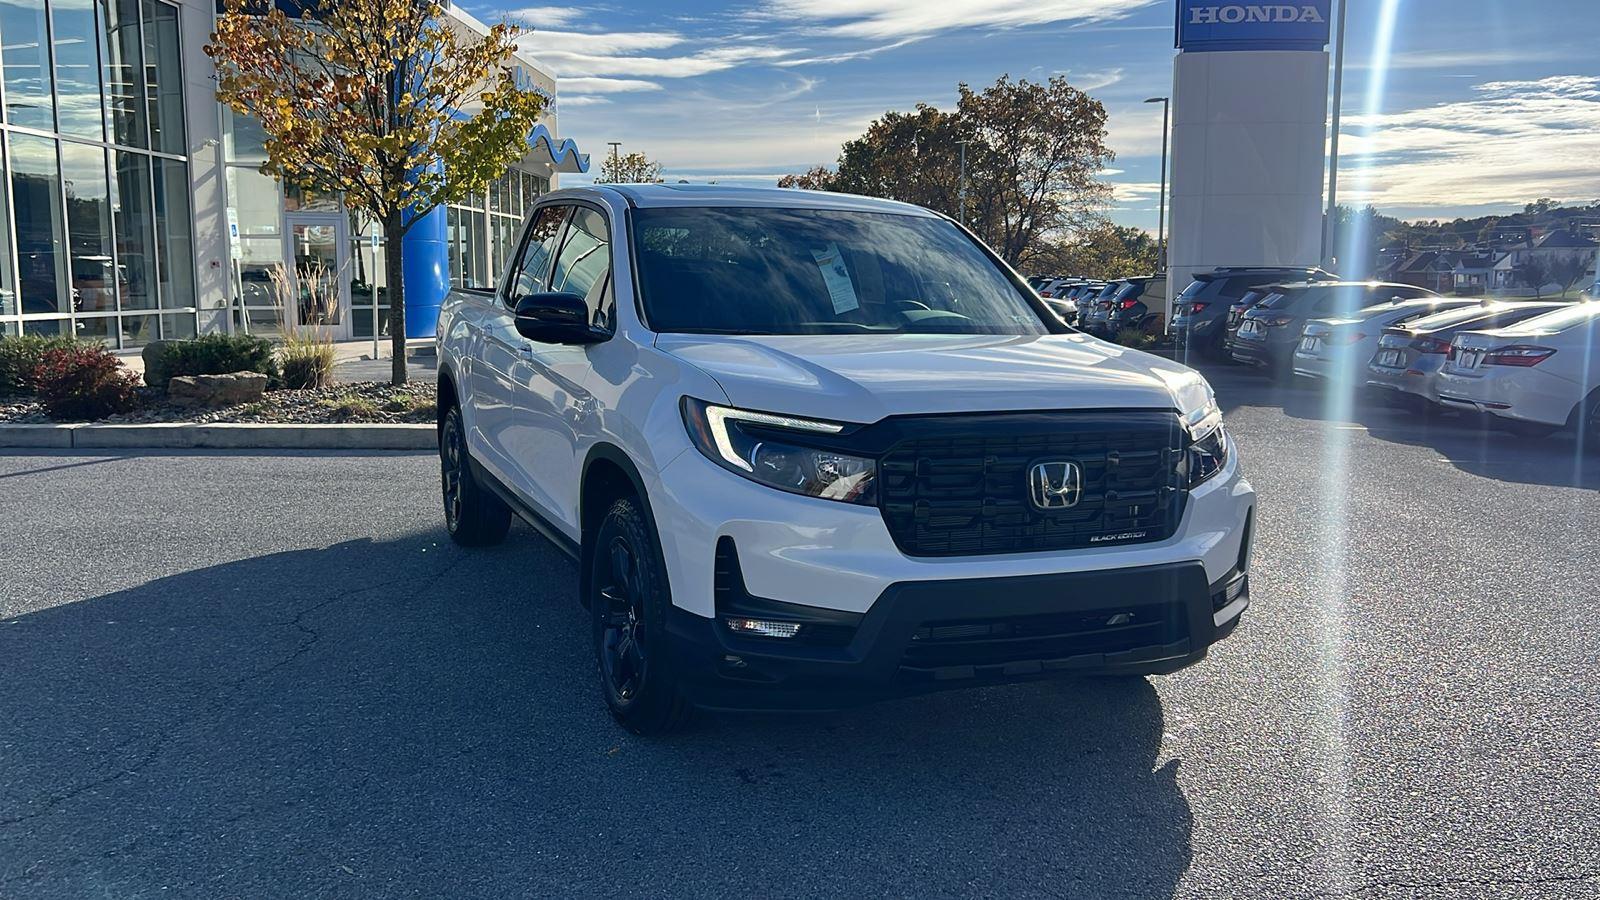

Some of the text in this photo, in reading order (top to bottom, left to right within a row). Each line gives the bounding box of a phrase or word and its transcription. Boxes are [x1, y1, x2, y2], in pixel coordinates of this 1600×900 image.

[1189, 5, 1325, 24] HONDA
[1090, 531, 1147, 542] BLACK EDITION
